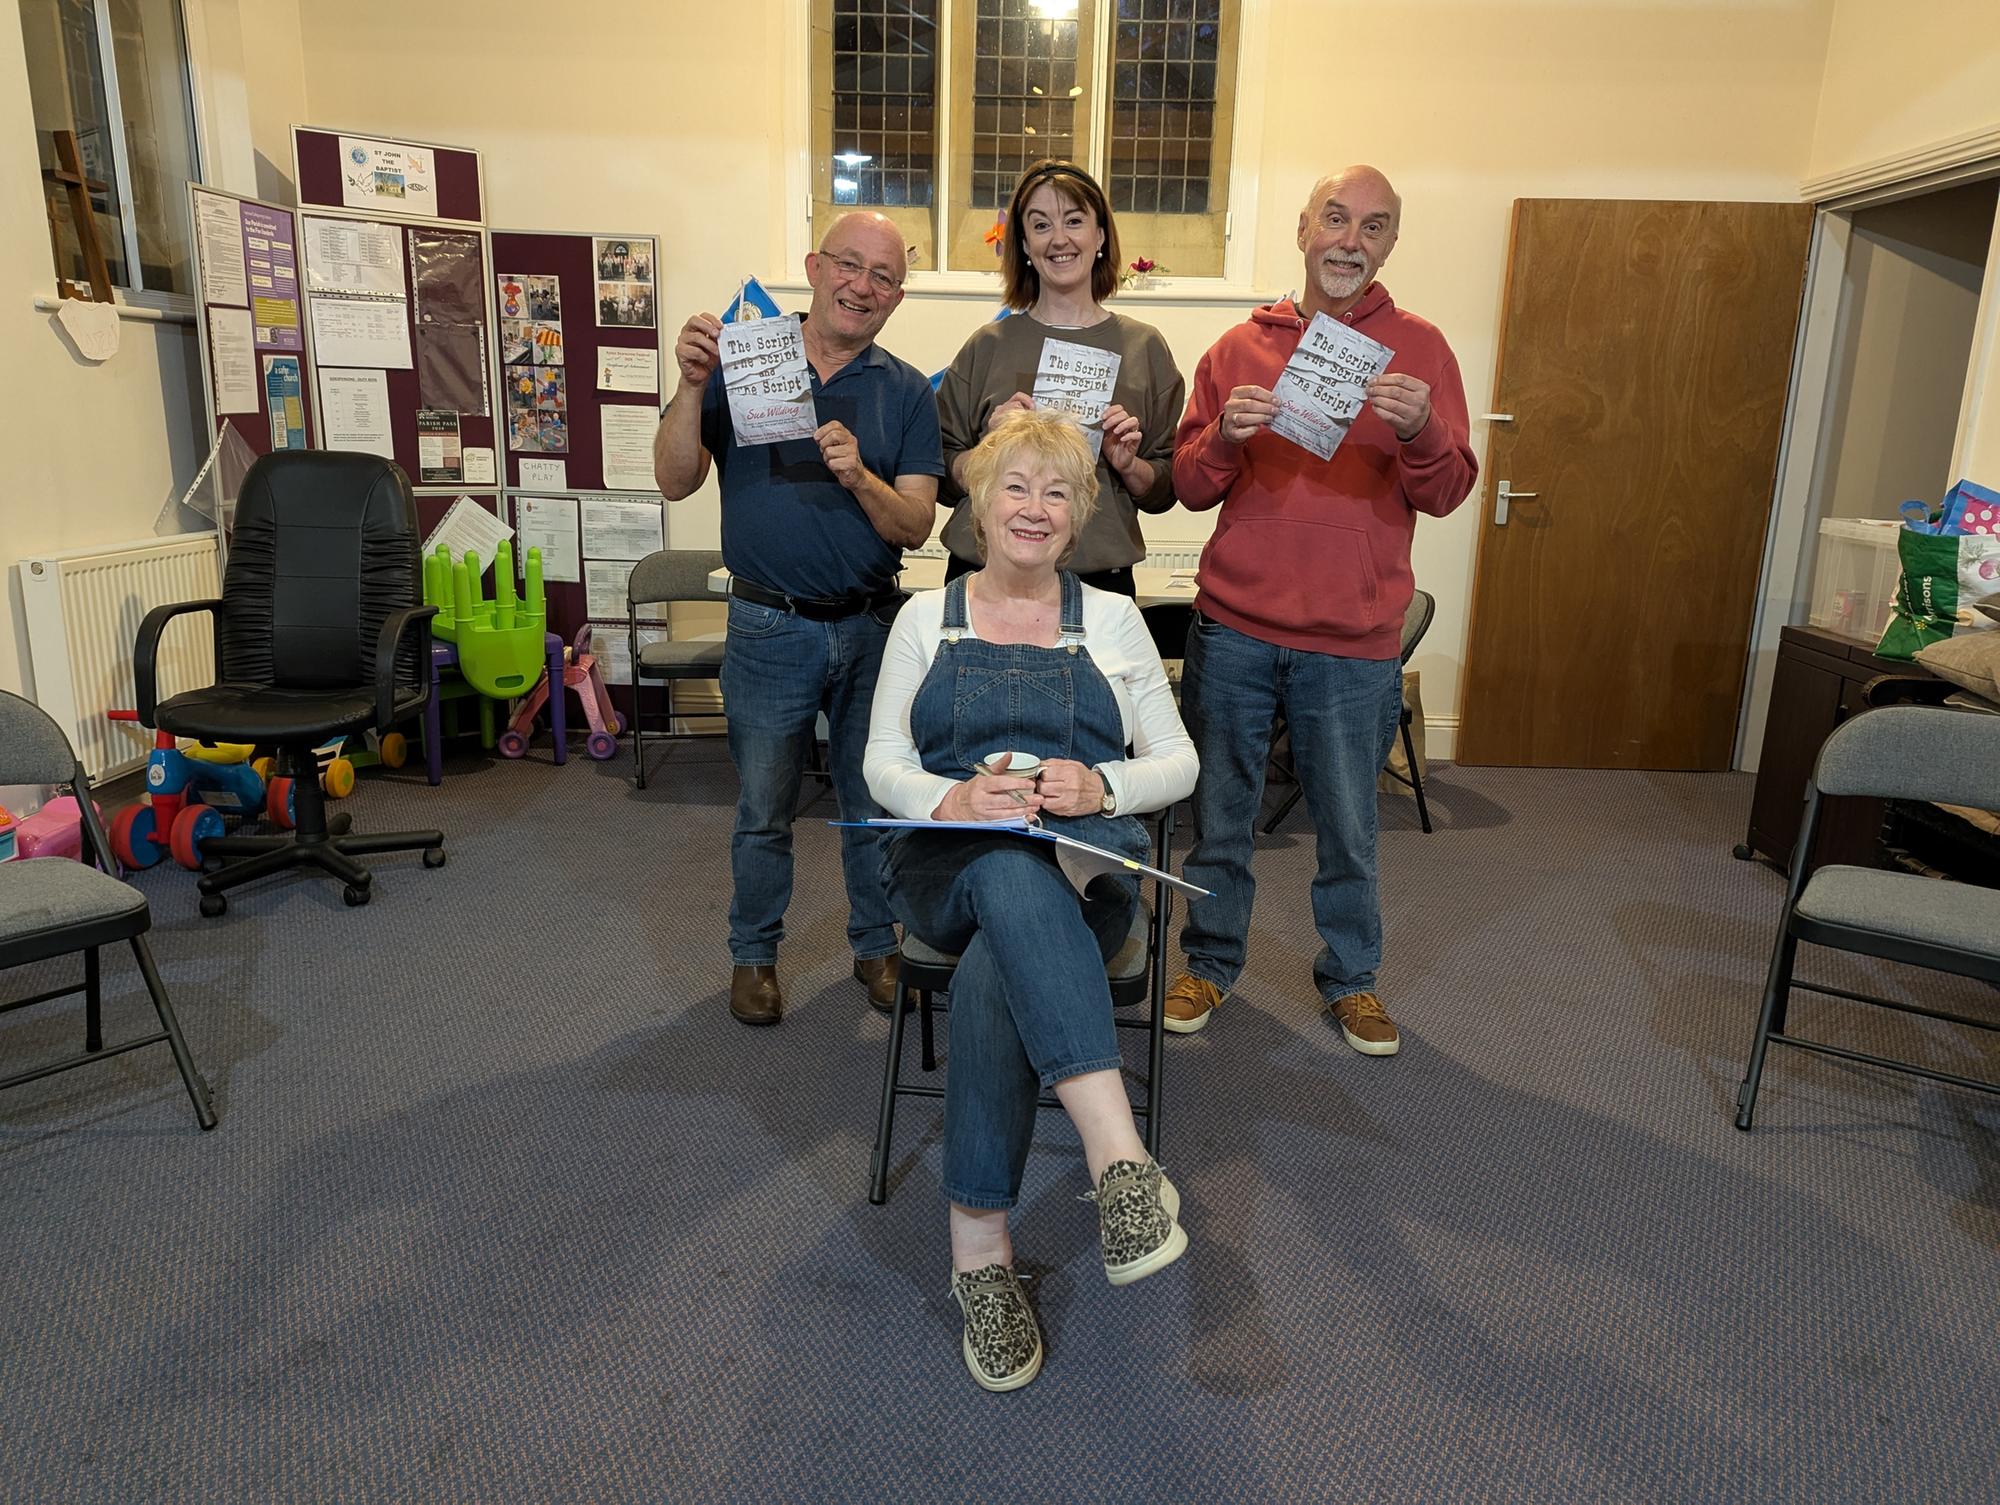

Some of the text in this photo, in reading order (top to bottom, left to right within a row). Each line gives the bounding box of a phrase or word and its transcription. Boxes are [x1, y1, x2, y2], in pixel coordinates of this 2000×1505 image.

[727, 332, 796, 355] The Script
[760, 348, 799, 366] Script
[1312, 332, 1334, 354] The
[1338, 346, 1378, 374] Script
[1049, 354, 1111, 378] The Script
[1330, 362, 1368, 388] Script
[283, 374, 298, 382] church
[763, 376, 802, 394] Script
[1071, 376, 1108, 391] Script
[1064, 399, 1100, 418] Script
[1313, 385, 1351, 415] Script
[747, 406, 800, 420] Sue Wilding
[1281, 400, 1301, 415] Sue
[1299, 409, 1331, 431] Wilding
[523, 462, 561, 471] CHATTY
[531, 472, 553, 481] PLAY
